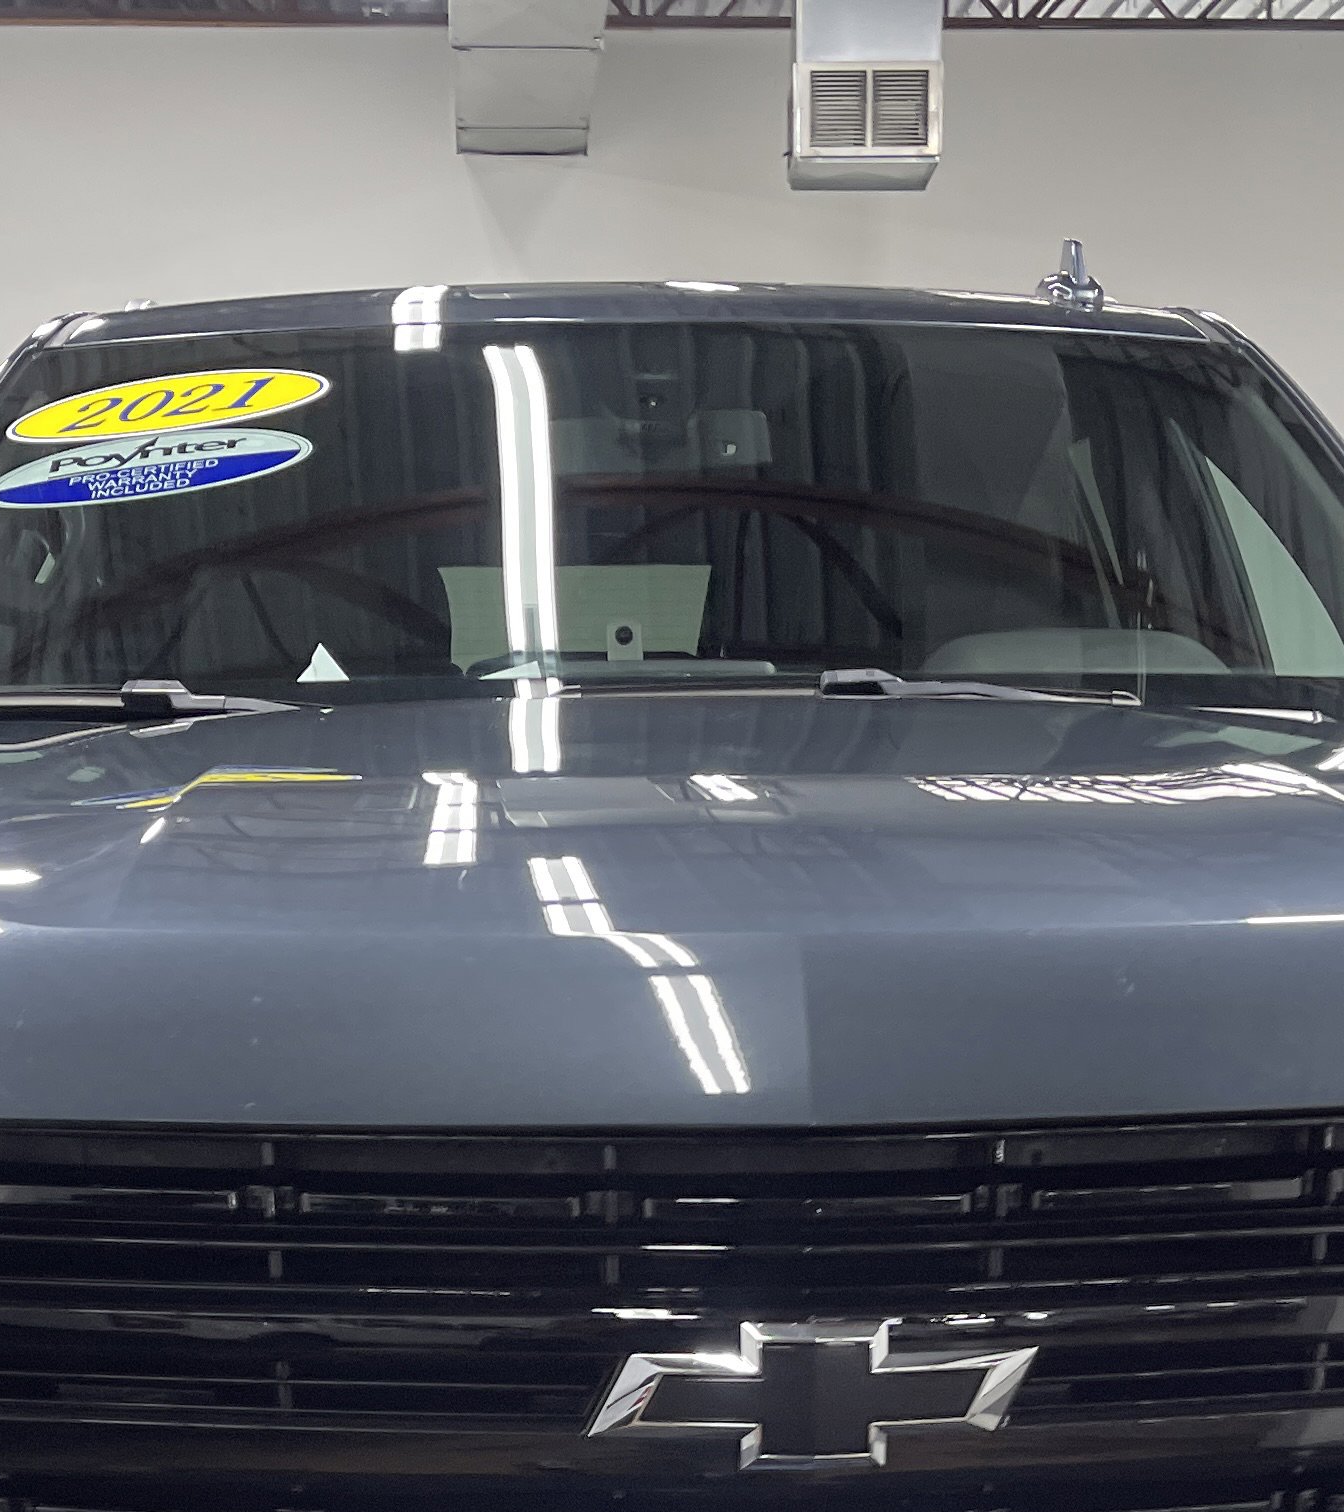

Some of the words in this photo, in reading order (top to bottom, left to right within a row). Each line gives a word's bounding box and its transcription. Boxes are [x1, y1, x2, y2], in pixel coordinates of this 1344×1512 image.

[57, 376, 274, 433] 2021
[47, 437, 247, 474] Poynter
[69, 459, 219, 487] PRO-CERTIFIED
[87, 470, 198, 491] WARRANTY
[91, 479, 190, 499] INCLUDED
